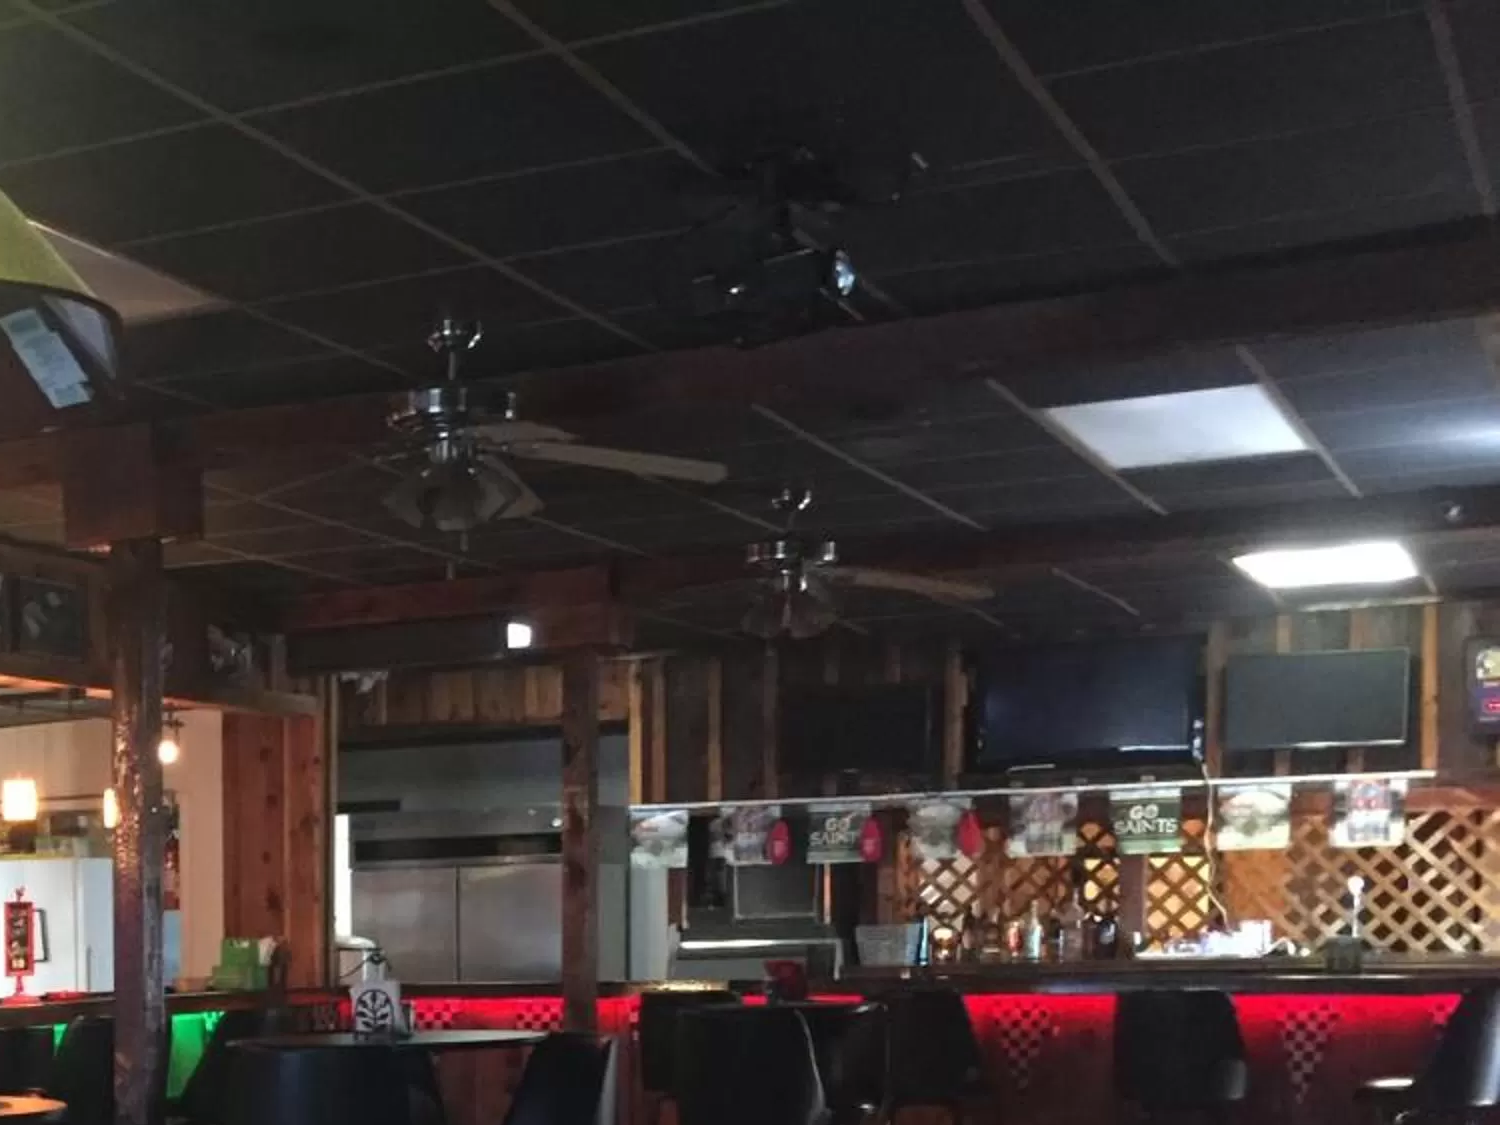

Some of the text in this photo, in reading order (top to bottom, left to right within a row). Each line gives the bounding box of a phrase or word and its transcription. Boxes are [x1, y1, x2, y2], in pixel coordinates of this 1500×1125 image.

[1129, 804, 1159, 820] GO
[1114, 818, 1179, 835] SAINTS
[809, 831, 861, 848] SAINT
